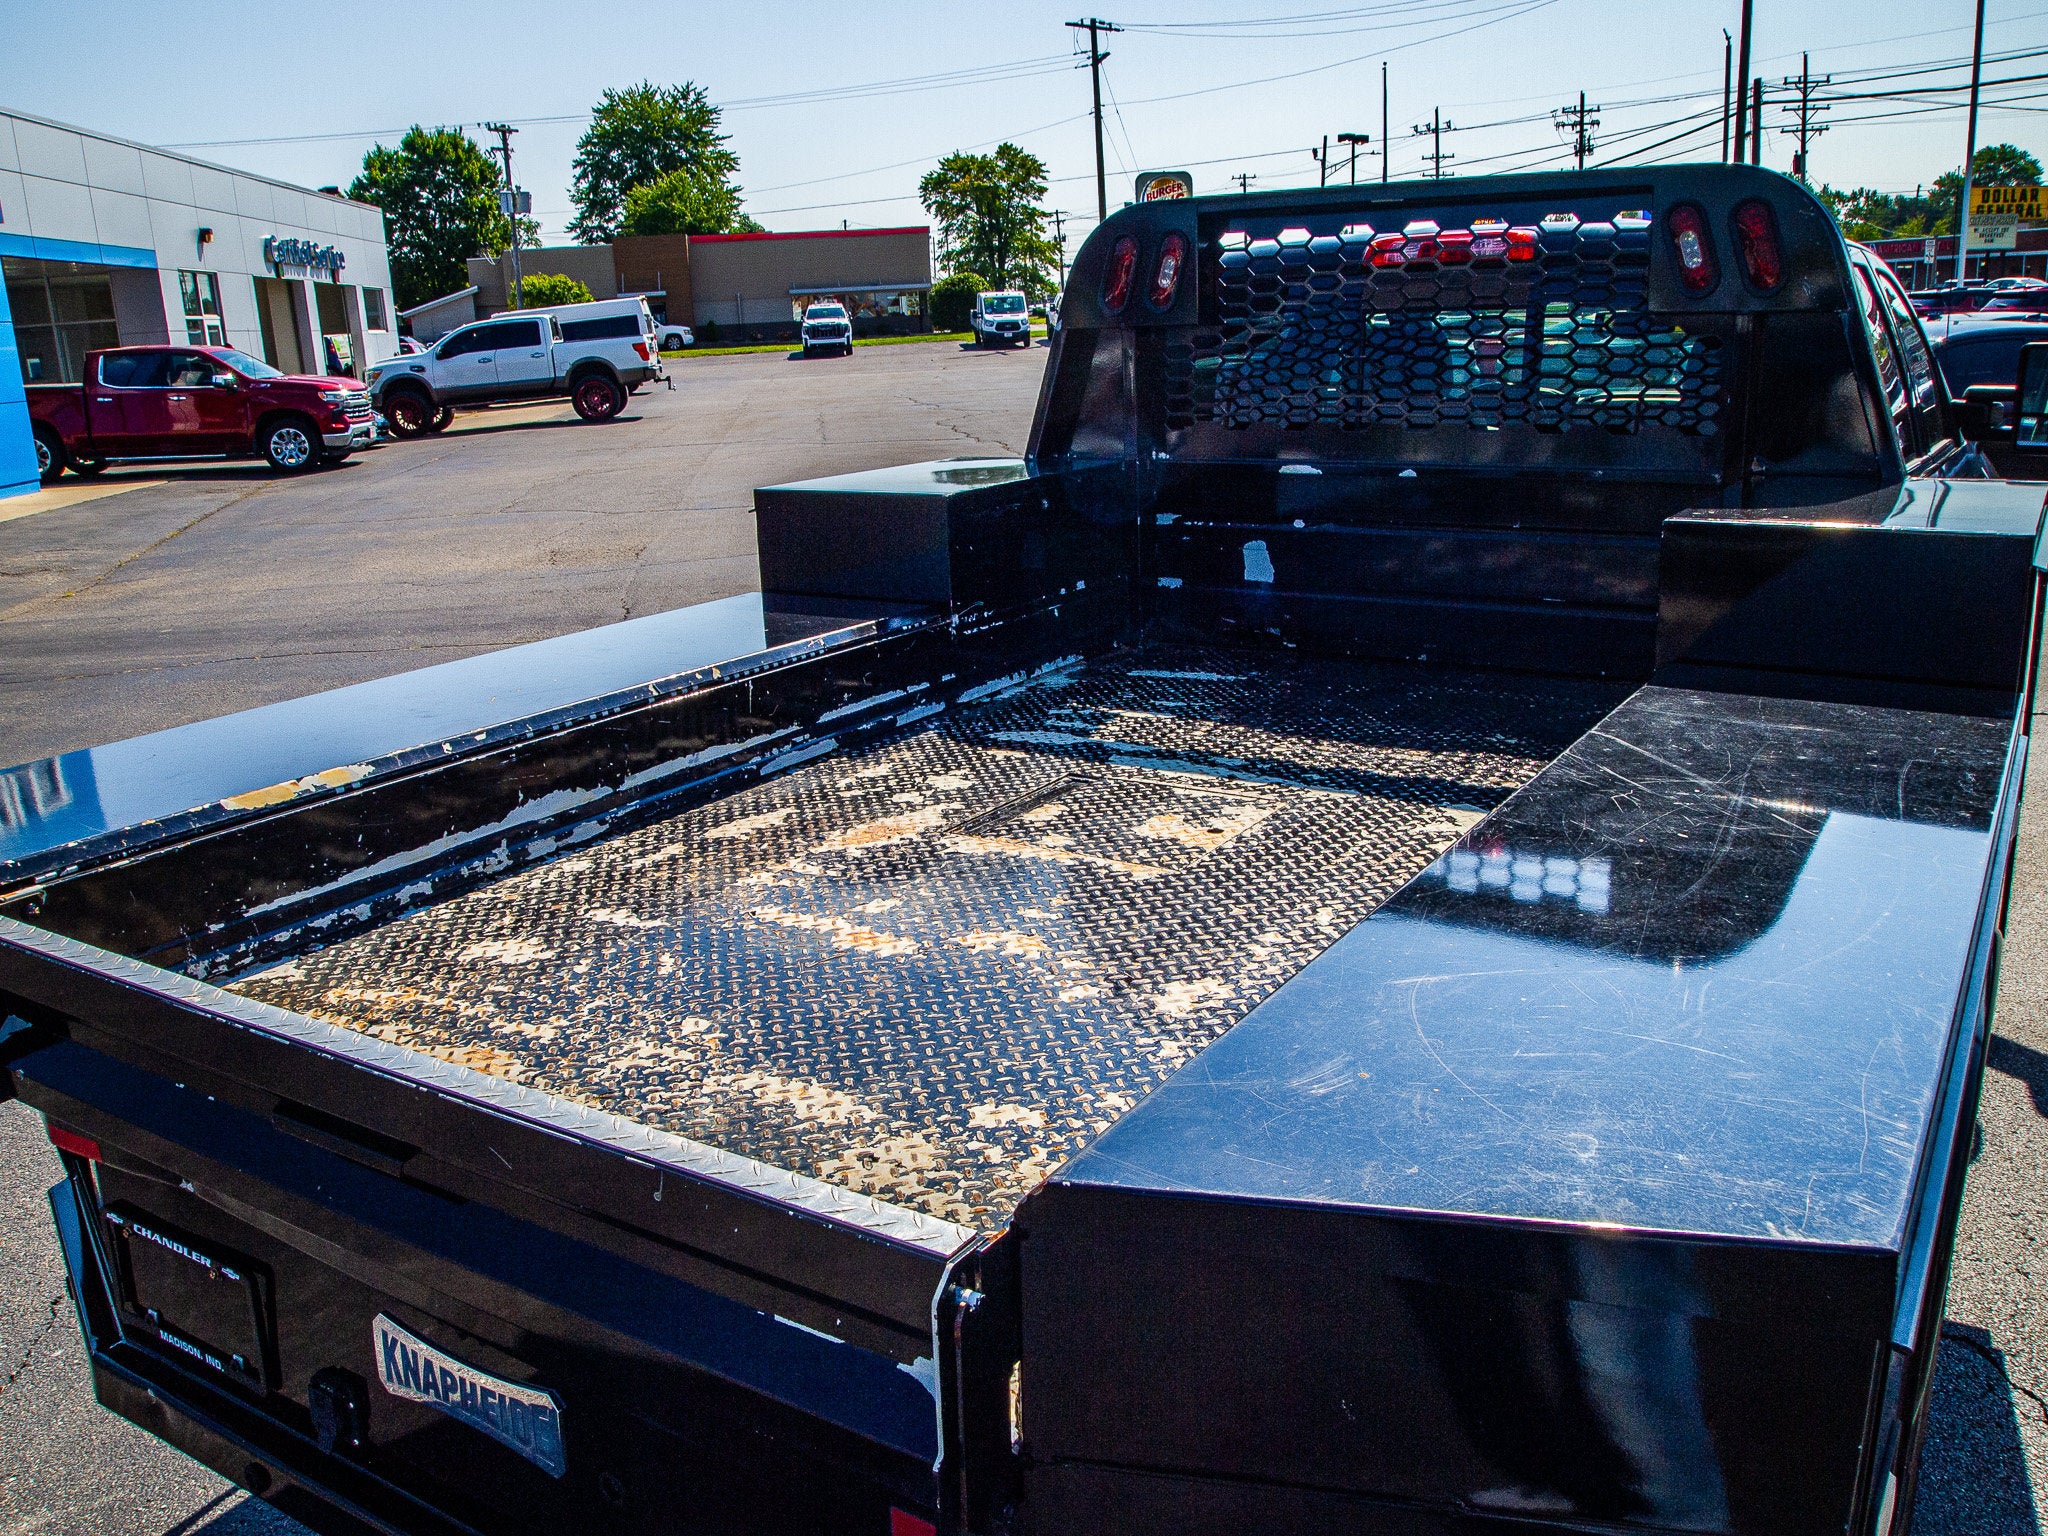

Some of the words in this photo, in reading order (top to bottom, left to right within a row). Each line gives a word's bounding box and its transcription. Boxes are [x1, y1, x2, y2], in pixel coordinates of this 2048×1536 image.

[1146, 183, 1183, 201] BURGER
[1981, 188, 2039, 203] DOLLAR
[1976, 203, 2042, 218] GENERAL
[133, 1224, 212, 1268] CHANDLER
[205, 1353, 225, 1372] IND.
[381, 1327, 556, 1467] KNAPHEIDE
